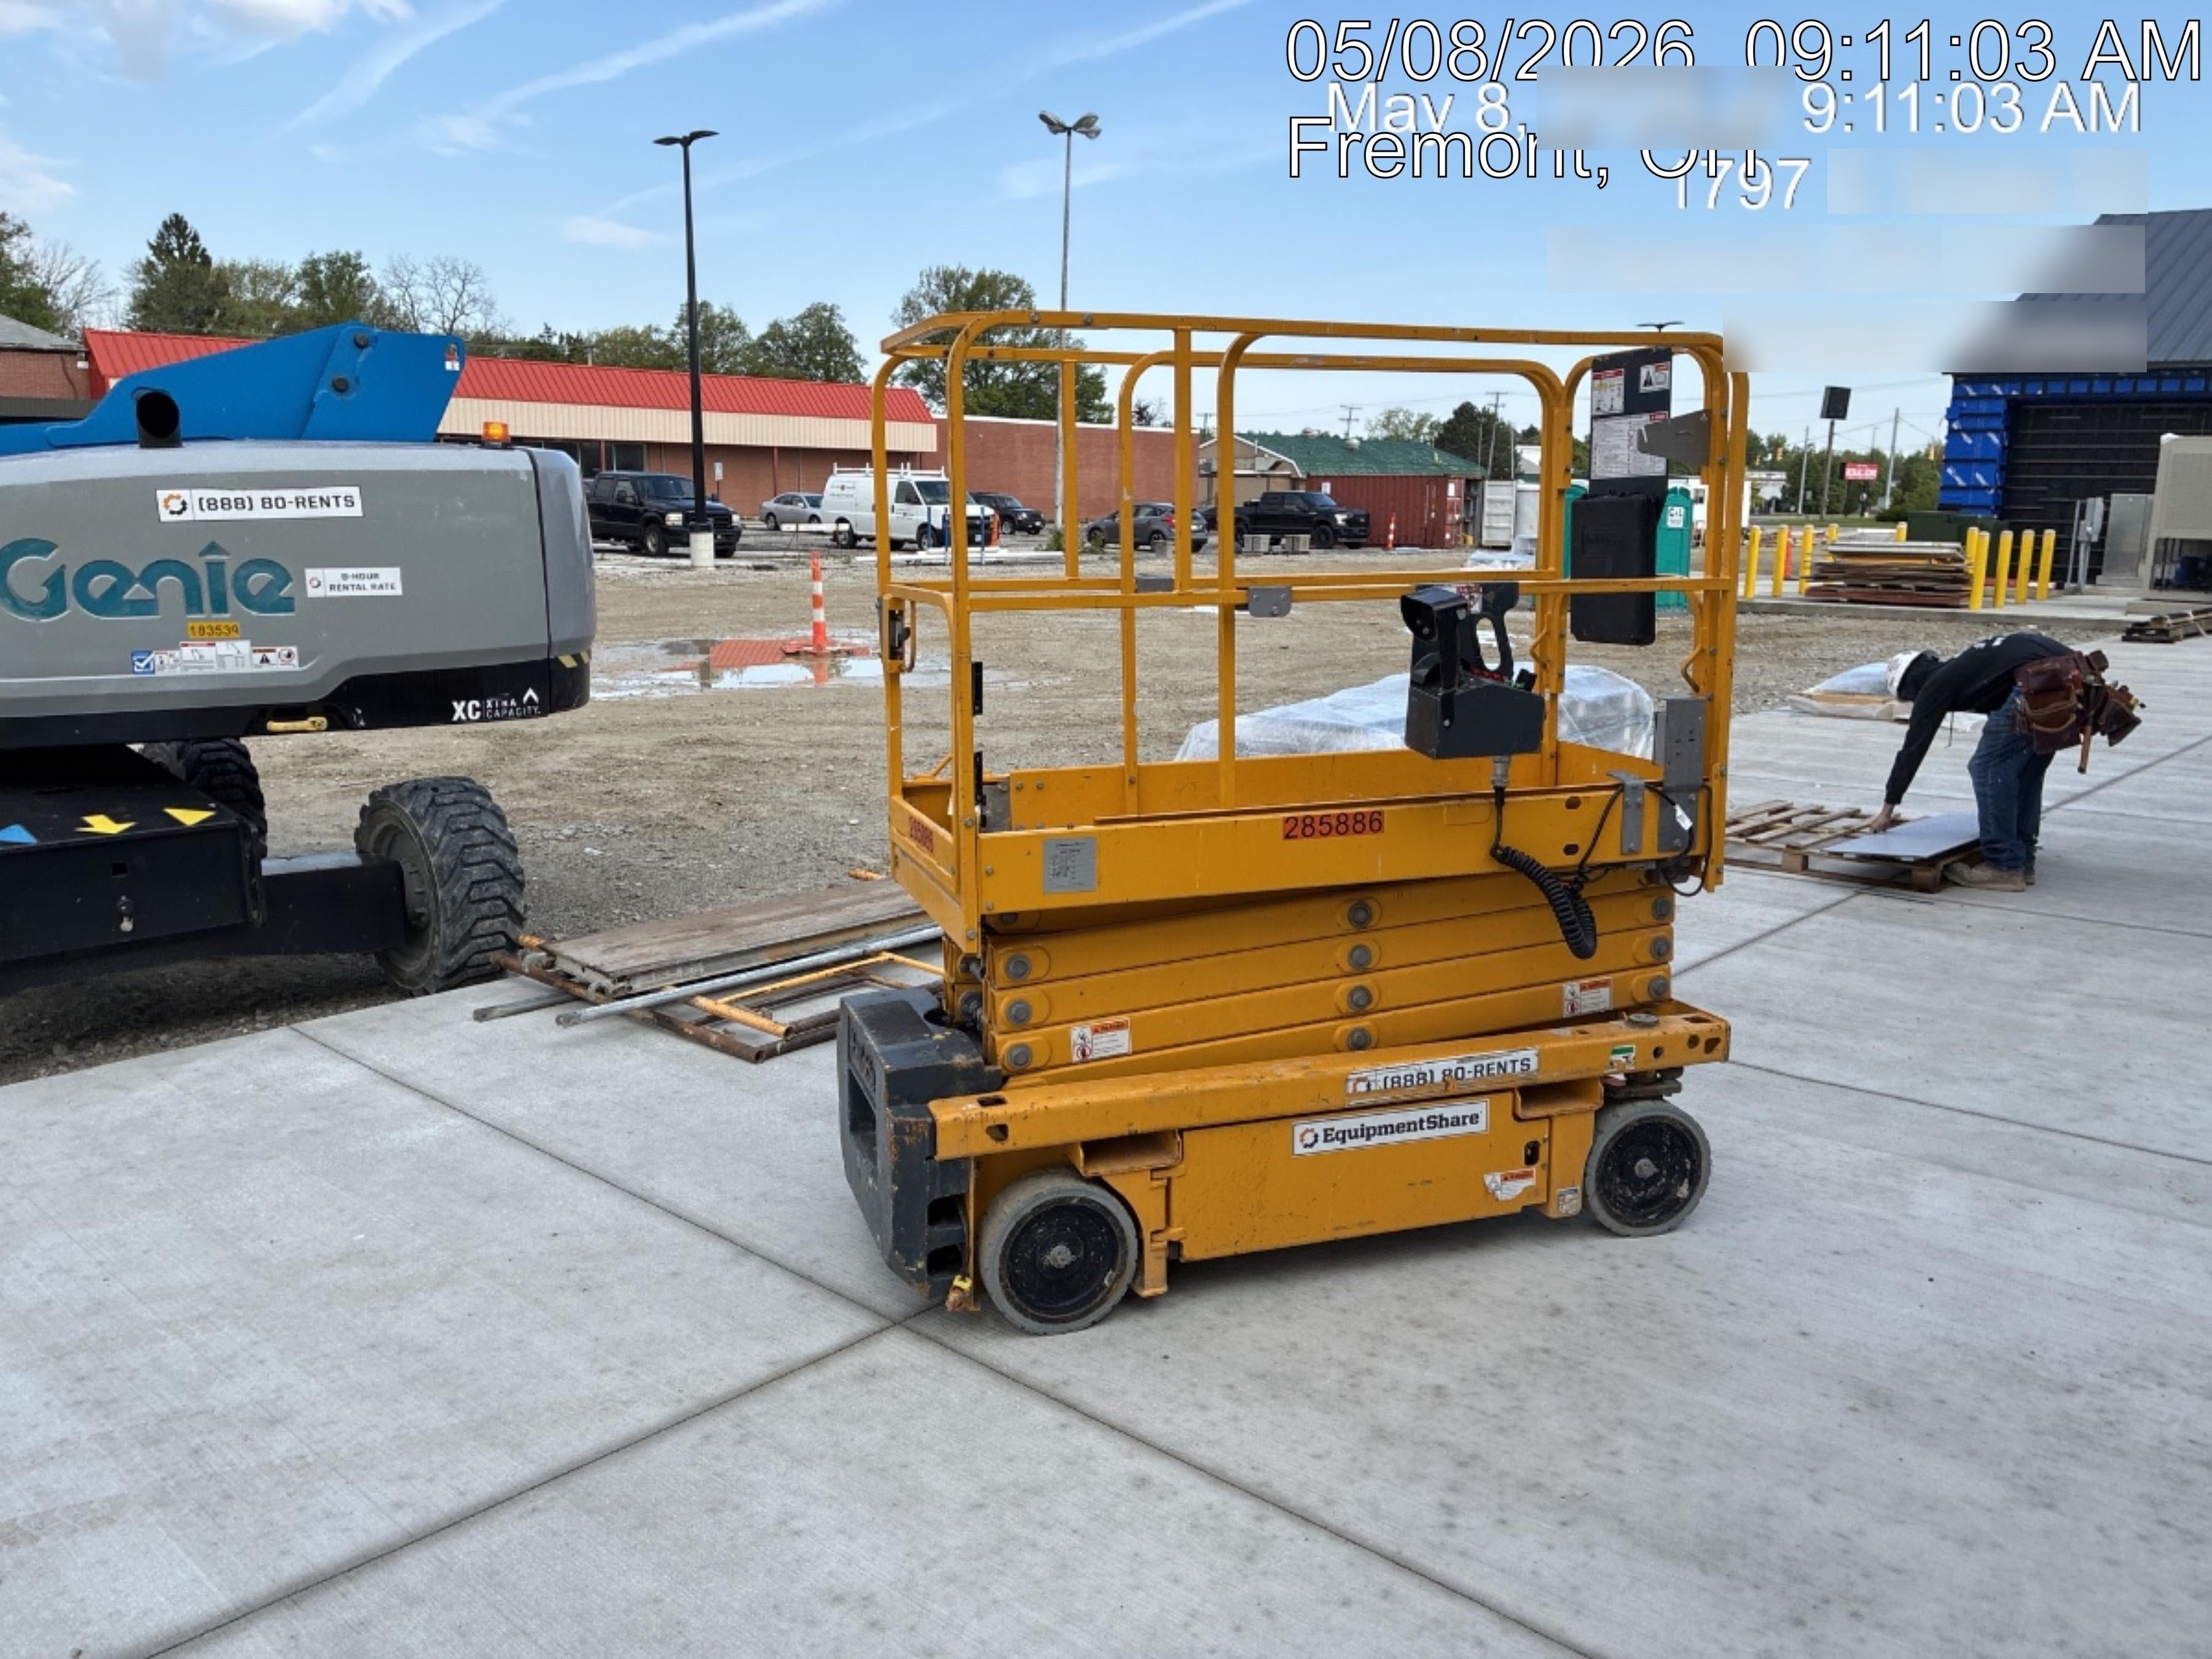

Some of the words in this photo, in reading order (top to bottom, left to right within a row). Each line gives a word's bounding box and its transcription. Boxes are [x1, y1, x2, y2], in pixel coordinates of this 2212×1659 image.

[198, 496, 253, 512] (888)
[261, 495, 355, 510] 80-RENTS
[0, 538, 296, 620] Genie
[329, 583, 367, 592] RENTAL
[452, 700, 482, 721] XC
[1284, 810, 1382, 839] 285886
[1322, 1112, 1480, 1145] EquipmentShare
